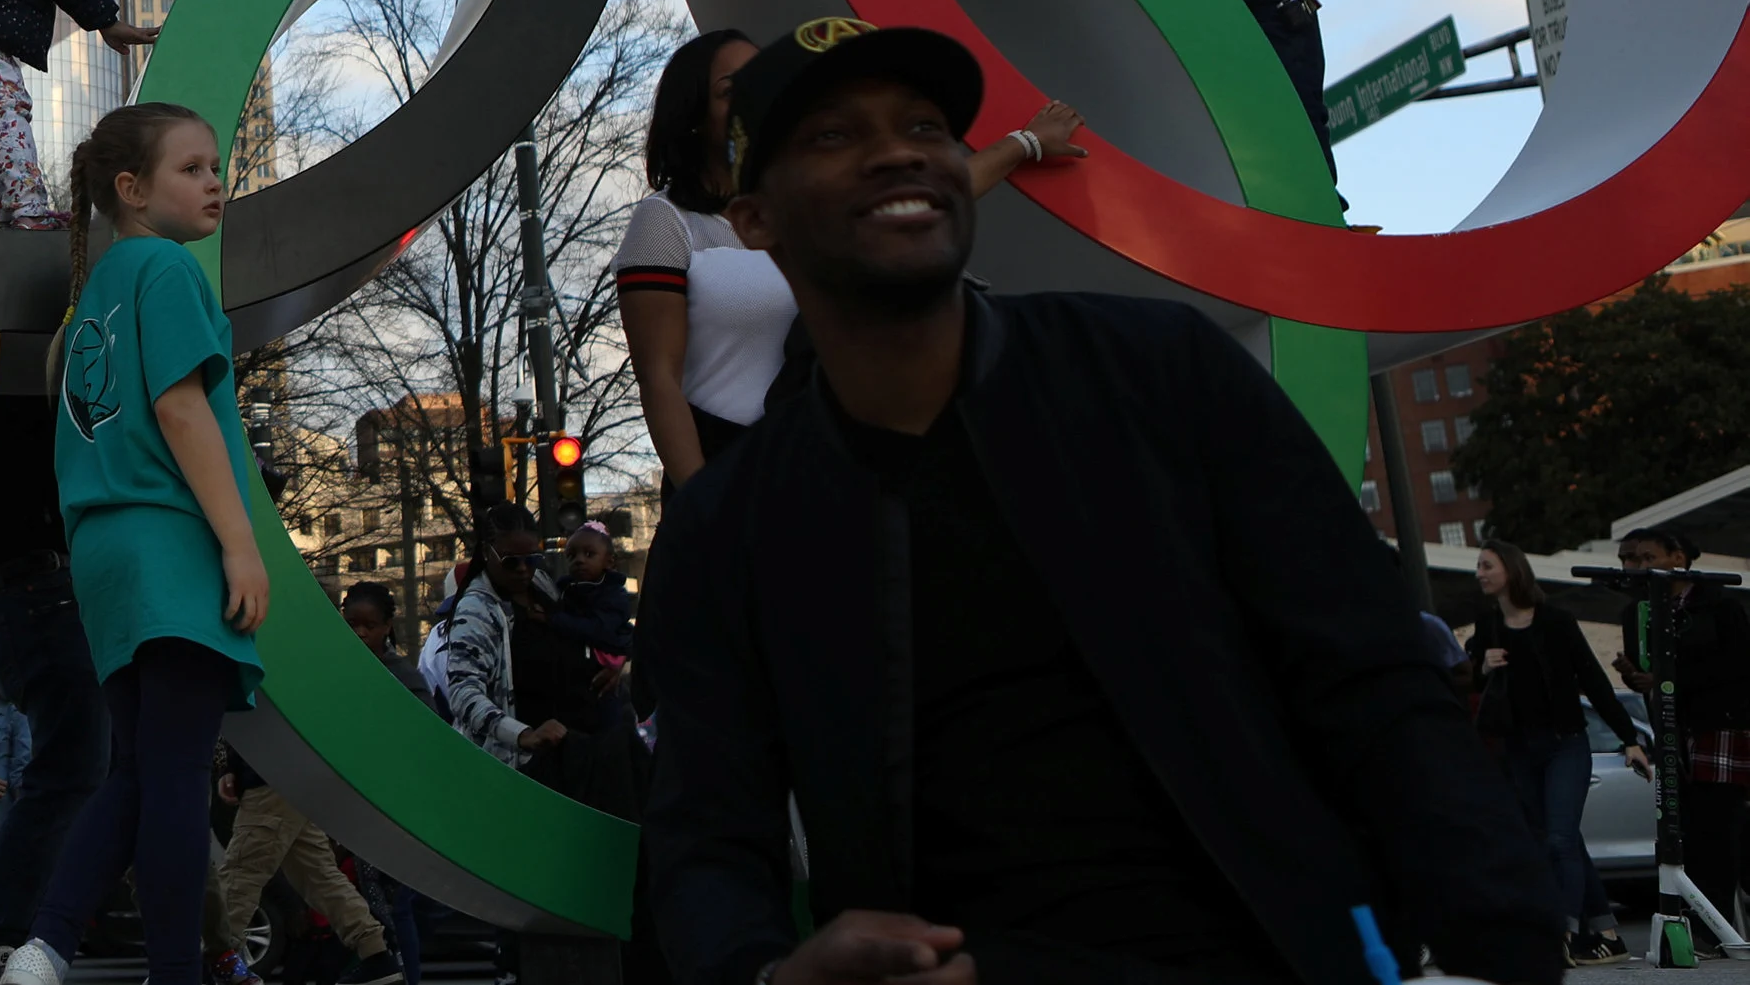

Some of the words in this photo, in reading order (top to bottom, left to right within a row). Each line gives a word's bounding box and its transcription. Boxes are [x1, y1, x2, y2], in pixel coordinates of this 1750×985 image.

[1547, 15, 1568, 47] TRU
[1326, 95, 1359, 128] oung
[1355, 46, 1431, 110] International
[1429, 25, 1452, 50] BLVD
[1439, 55, 1455, 77] NW
